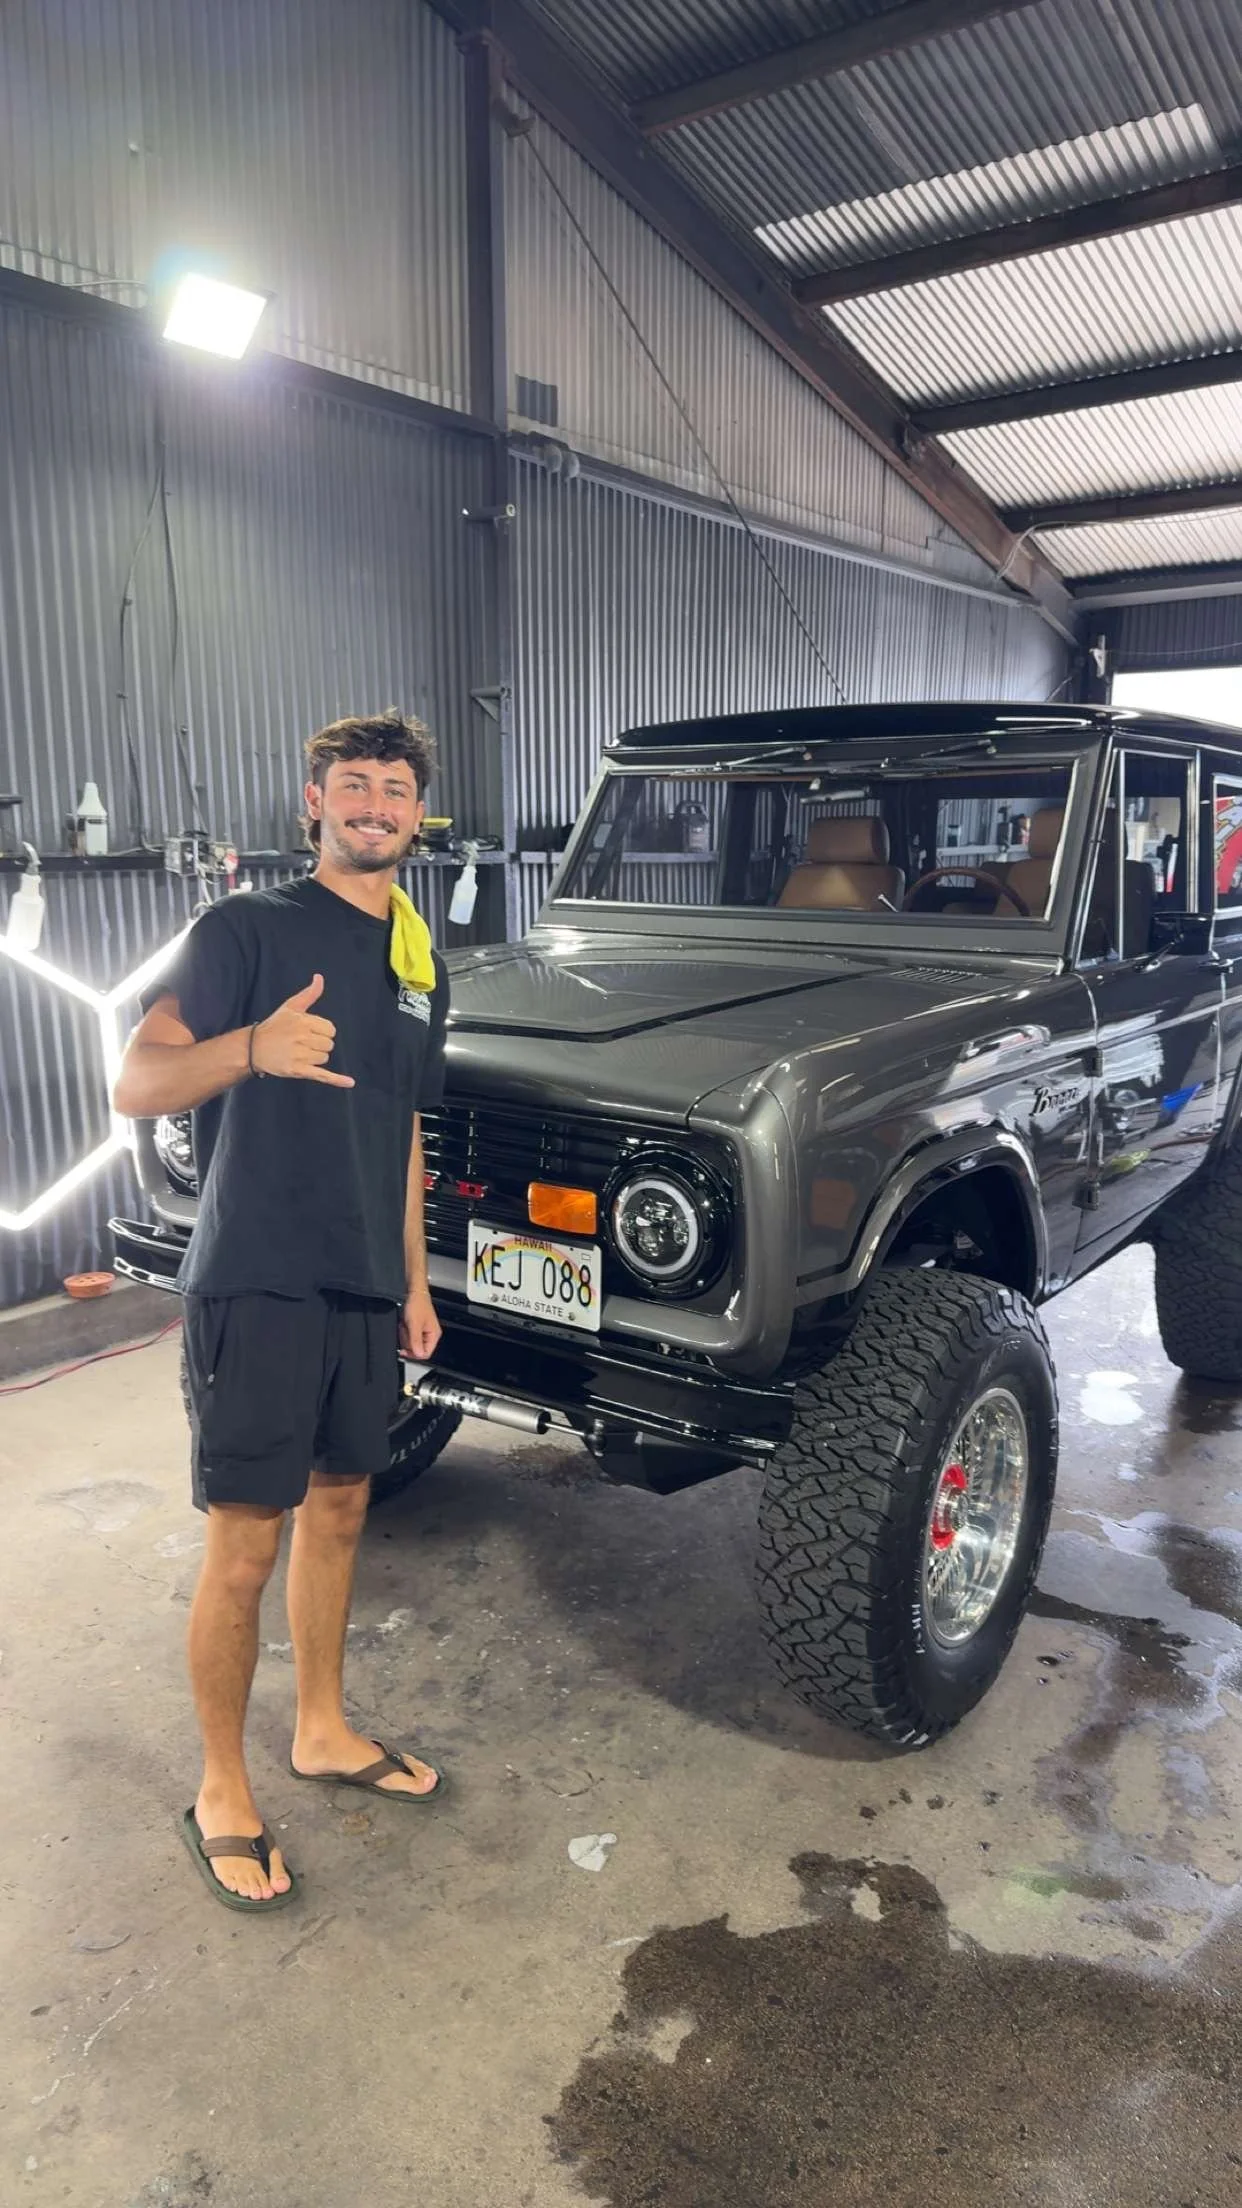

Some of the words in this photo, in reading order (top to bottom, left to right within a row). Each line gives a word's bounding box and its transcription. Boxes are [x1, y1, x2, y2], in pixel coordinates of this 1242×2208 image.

[514, 1236, 552, 1252] HAWAII
[474, 1240, 523, 1290] KEJ
[542, 1256, 591, 1307] 088
[501, 1294, 532, 1309] ALOHA
[534, 1301, 565, 1317] STATE
